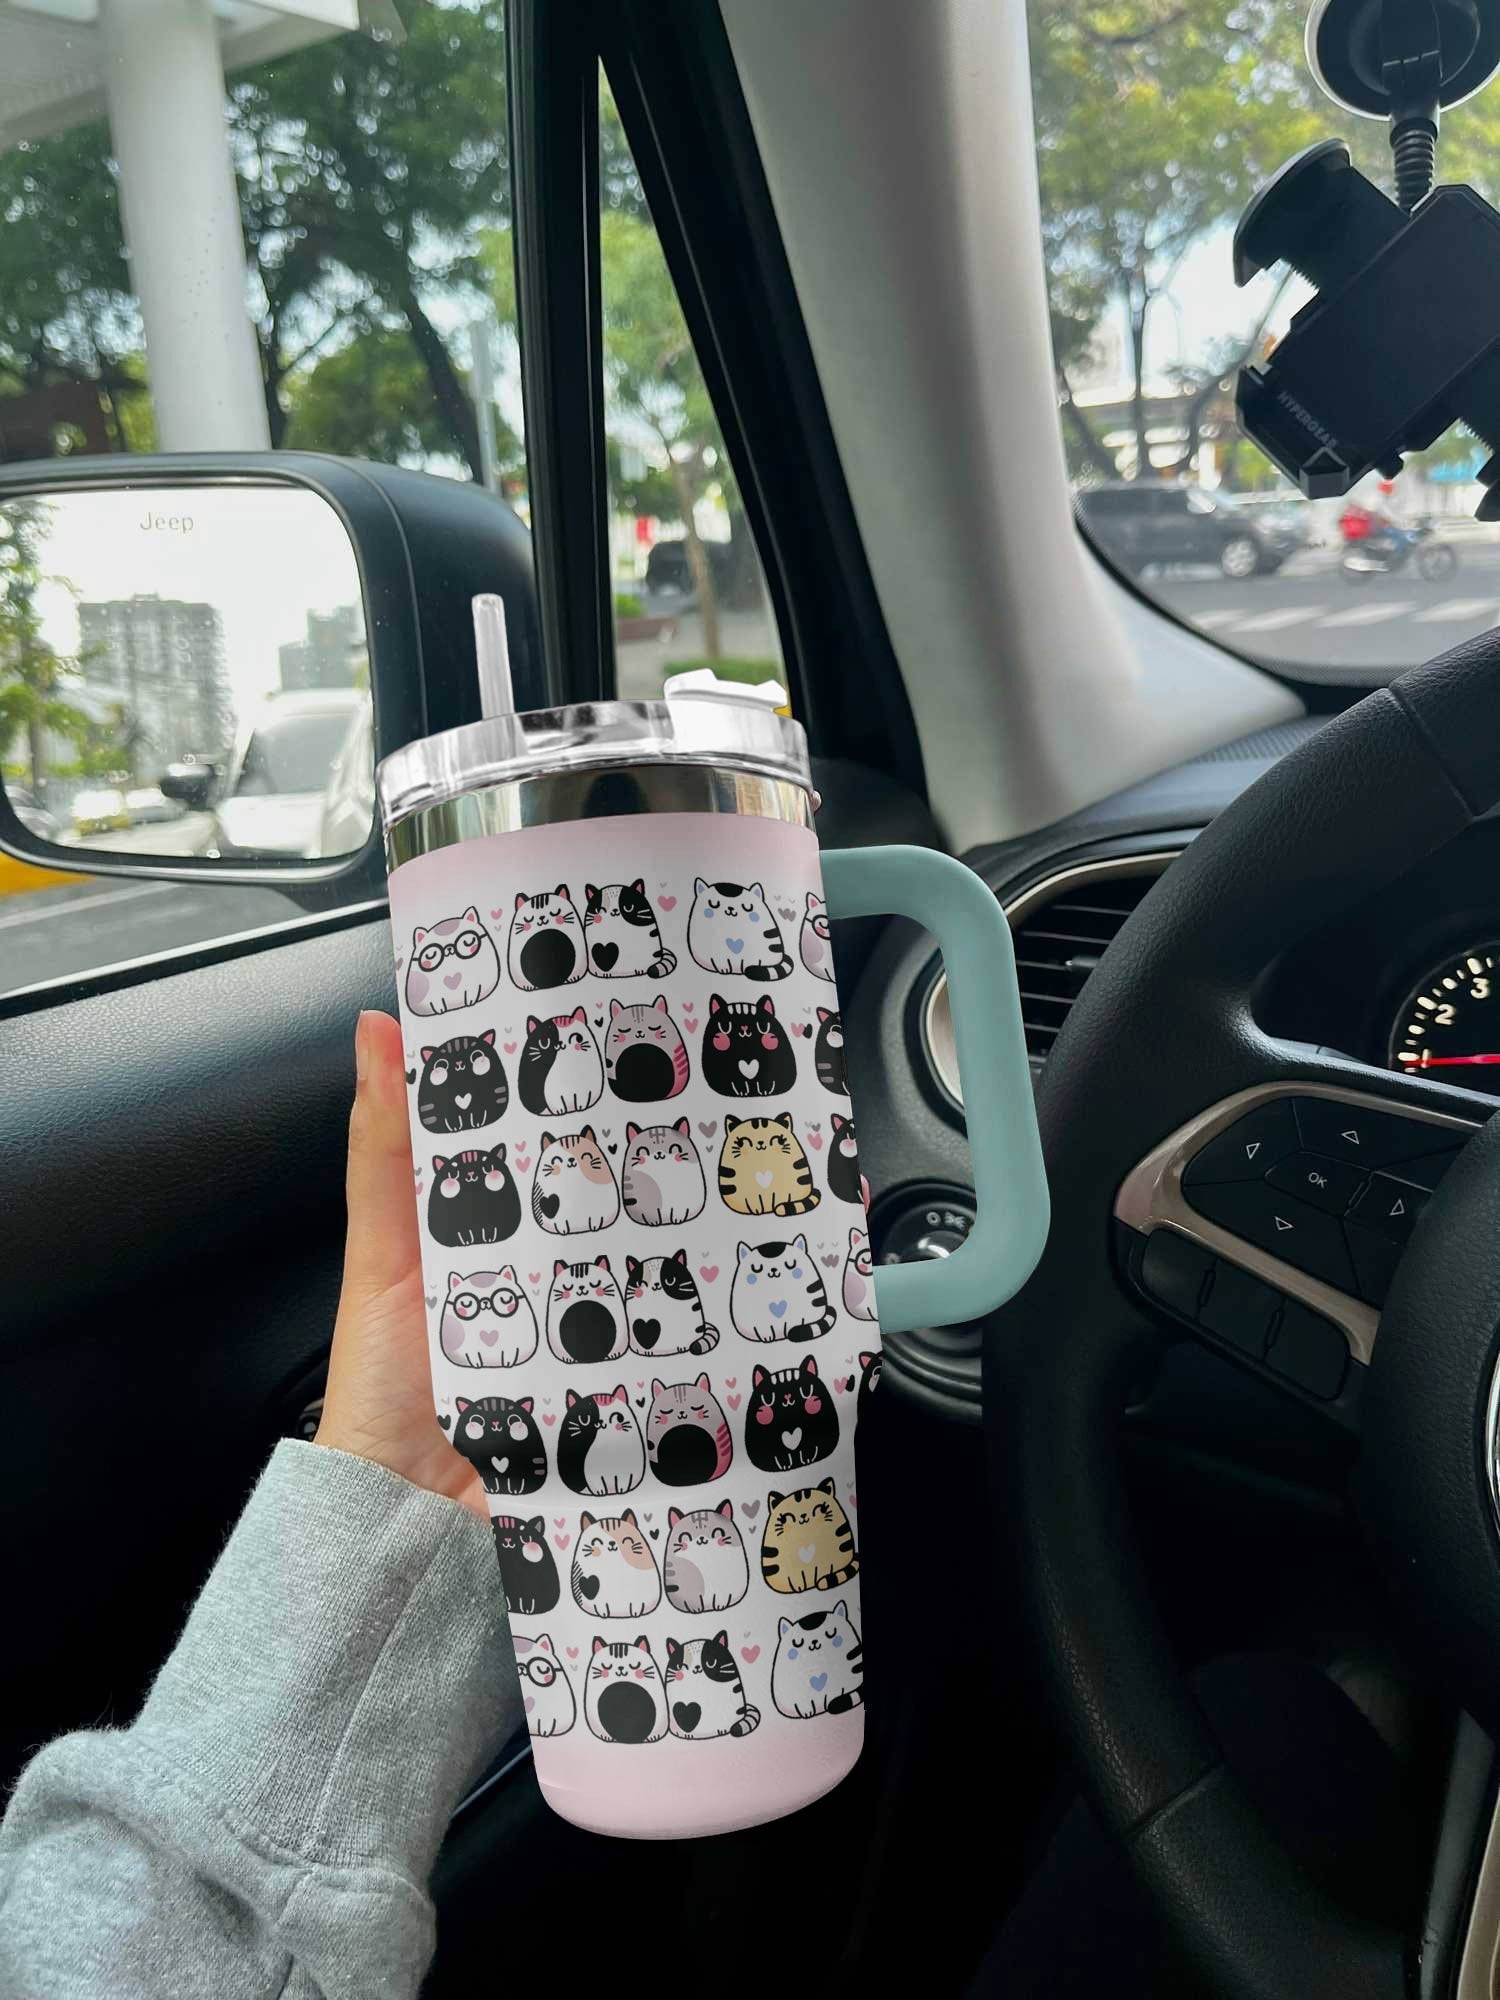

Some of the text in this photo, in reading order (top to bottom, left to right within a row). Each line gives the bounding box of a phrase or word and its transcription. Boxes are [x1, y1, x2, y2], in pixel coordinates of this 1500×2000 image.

[1277, 390, 1338, 449] HYPERGEAR
[139, 511, 194, 535] Jeep
[1470, 977, 1491, 999] 3
[1434, 1003, 1456, 1025] 2
[1308, 1172, 1328, 1189] OK
